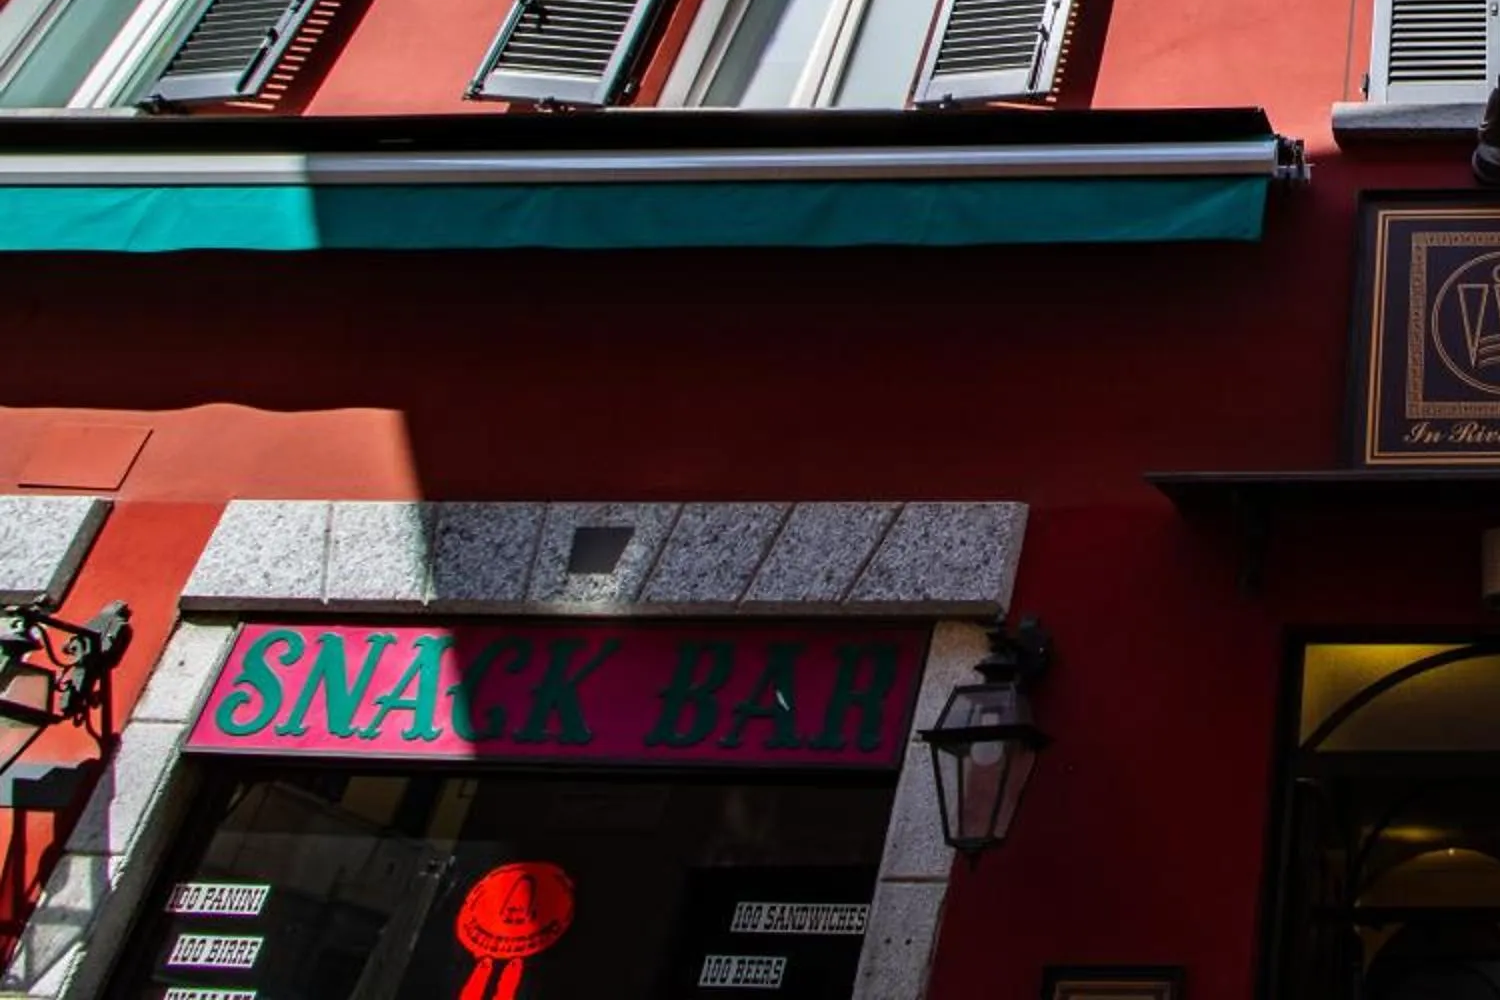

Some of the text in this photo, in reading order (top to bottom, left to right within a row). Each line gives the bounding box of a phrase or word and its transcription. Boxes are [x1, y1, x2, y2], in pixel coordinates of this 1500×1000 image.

[1402, 420, 1444, 444] In
[215, 630, 896, 752] SNACK BAR
[170, 886, 266, 911] 100 PANINI
[733, 904, 867, 931] 100 SANDWICHES
[171, 937, 260, 965] 100 BIRRE
[702, 957, 784, 985] 100 BEERS
